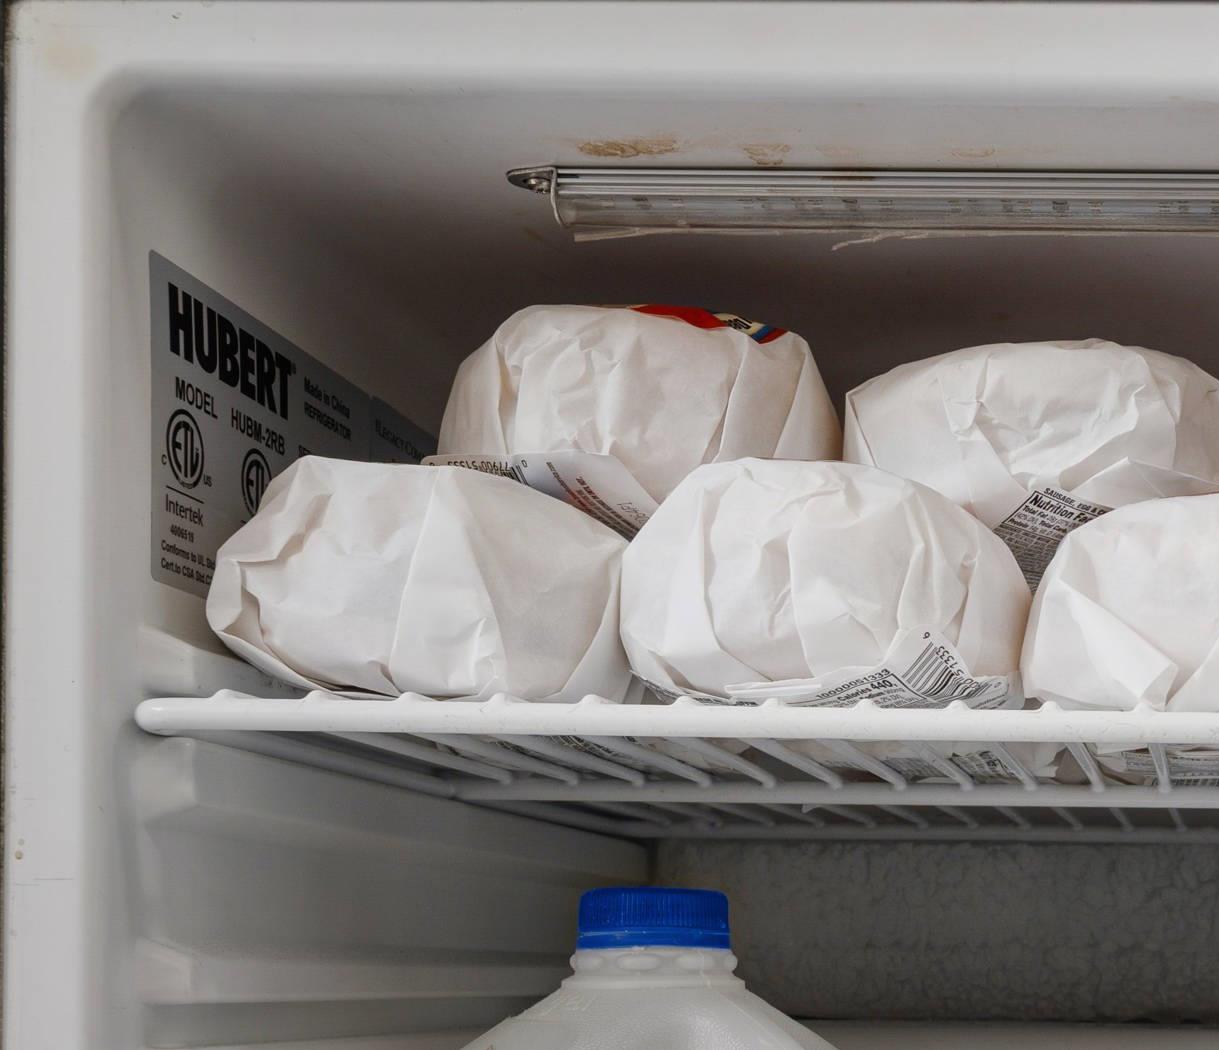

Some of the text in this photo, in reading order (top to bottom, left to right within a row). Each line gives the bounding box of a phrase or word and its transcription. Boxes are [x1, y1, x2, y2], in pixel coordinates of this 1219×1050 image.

[168, 282, 292, 421] HUBERT
[175, 377, 286, 456] MODEL HUBM-2RB
[304, 402, 352, 440] REFRIGERATOR
[165, 493, 204, 527] Intertek
[1029, 494, 1074, 519] Nutrition
[1044, 487, 1076, 507] SAUSAGE,
[161, 540, 190, 560] Conforms
[870, 679, 897, 691] 440,
